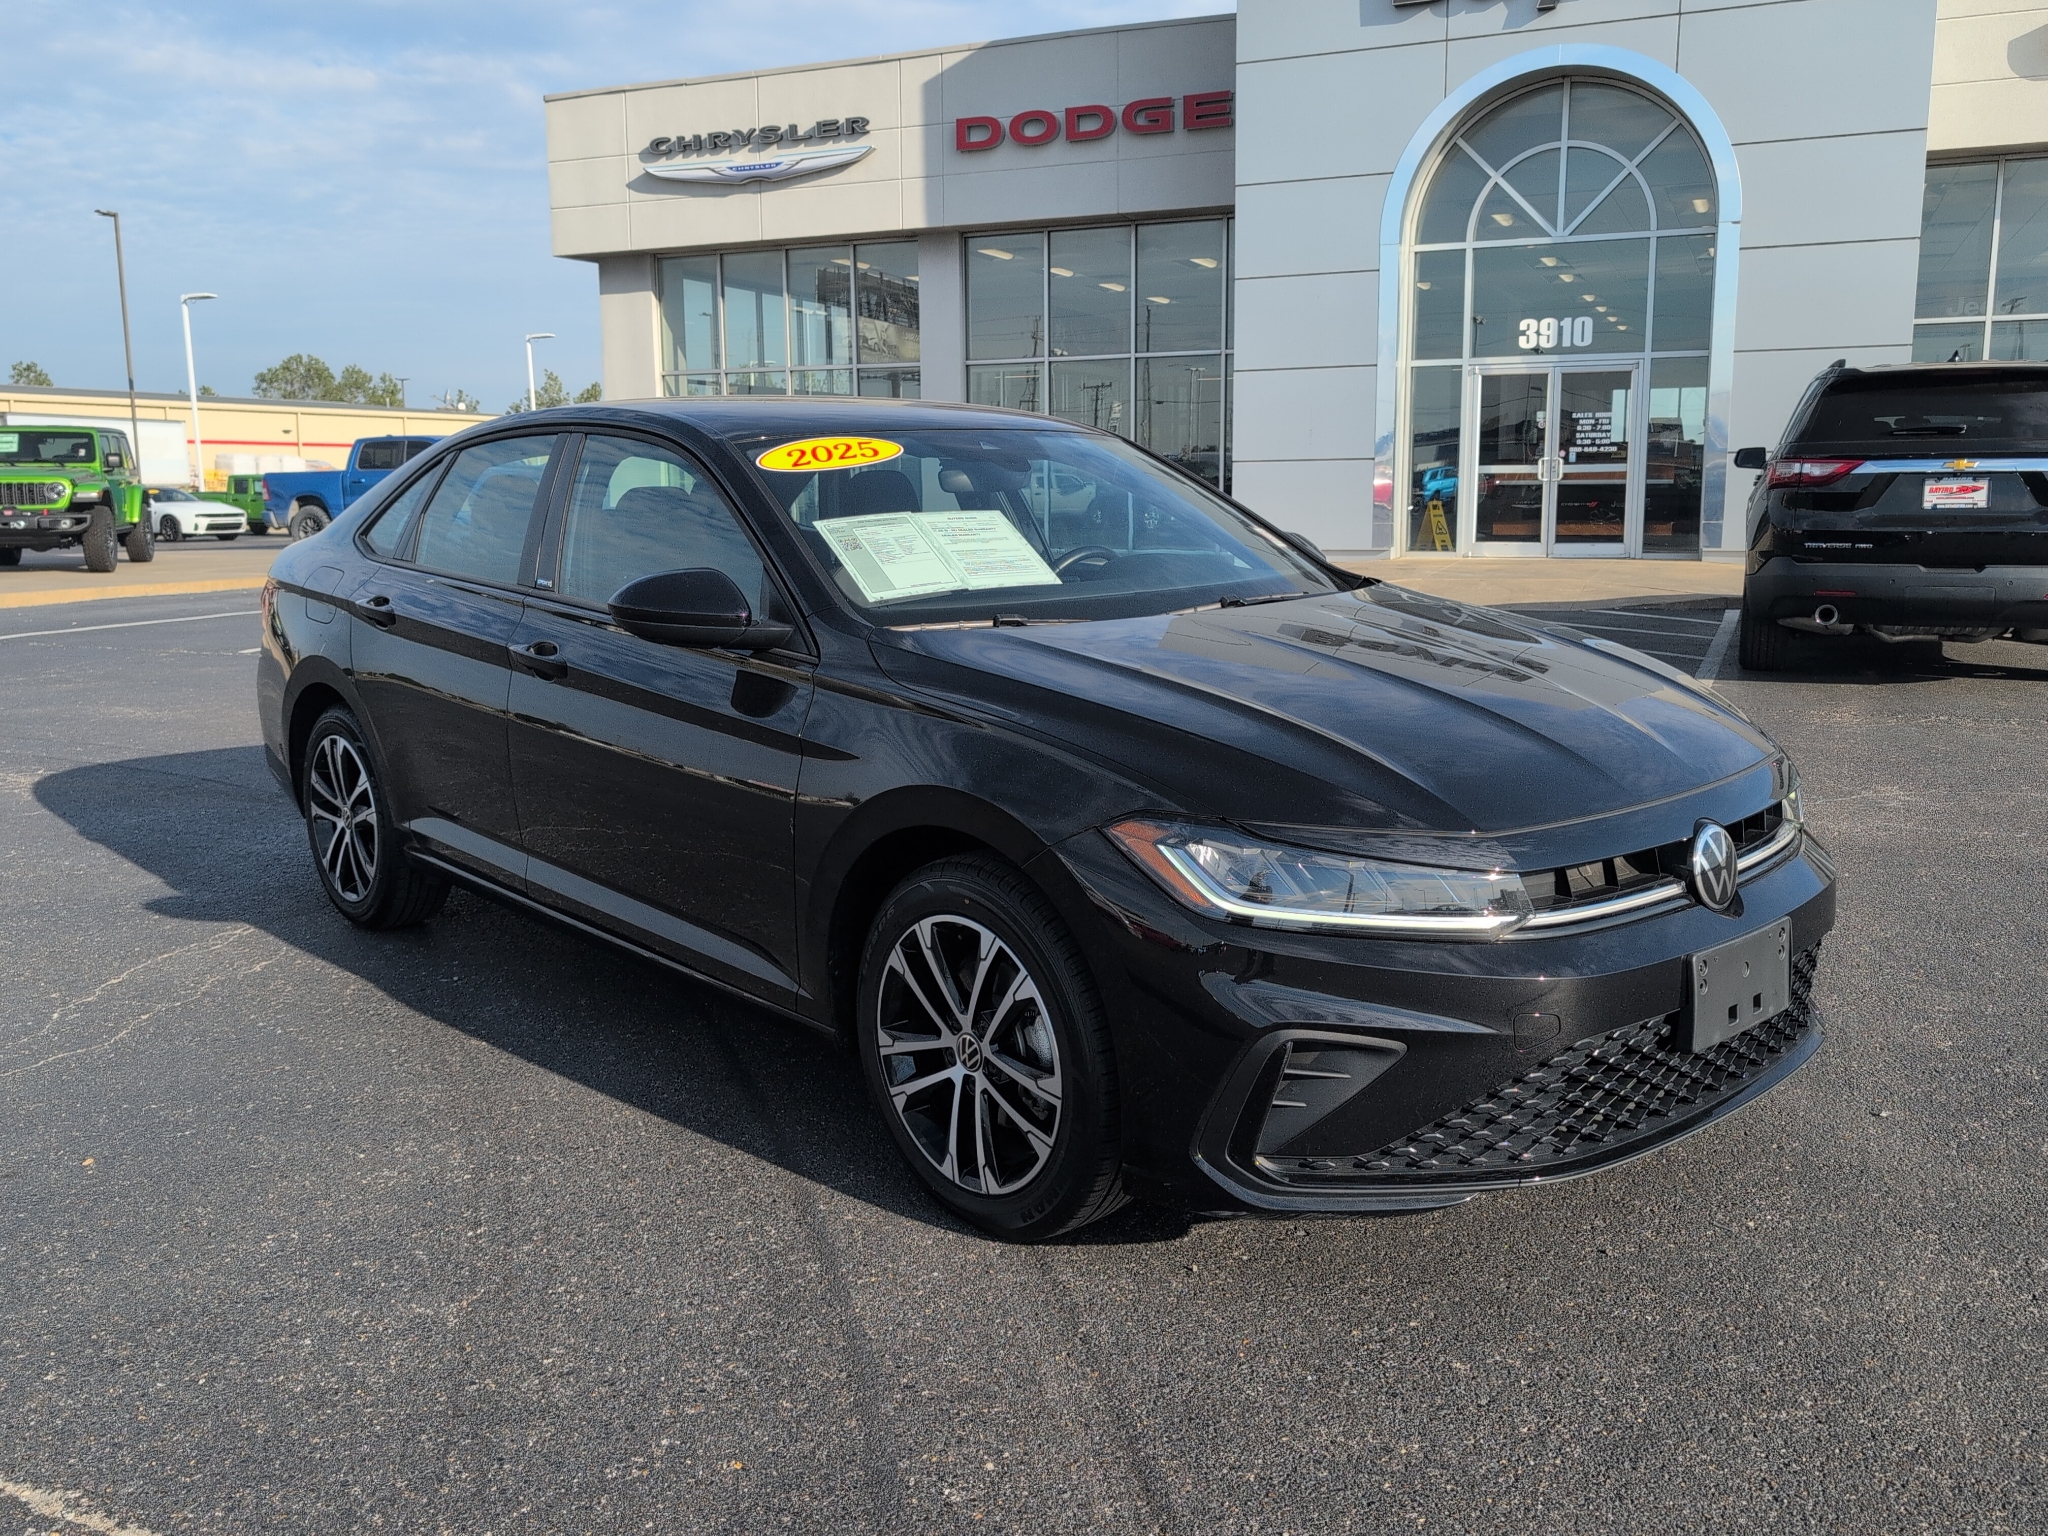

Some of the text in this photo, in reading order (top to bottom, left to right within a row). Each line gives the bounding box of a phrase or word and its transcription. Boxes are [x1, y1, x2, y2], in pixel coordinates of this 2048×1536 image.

[649, 116, 870, 155] CHRYSLER
[956, 90, 1234, 152] DODGE
[732, 163, 777, 171] CHRYSLER
[1518, 316, 1594, 349] 3910
[786, 441, 880, 468] 2025
